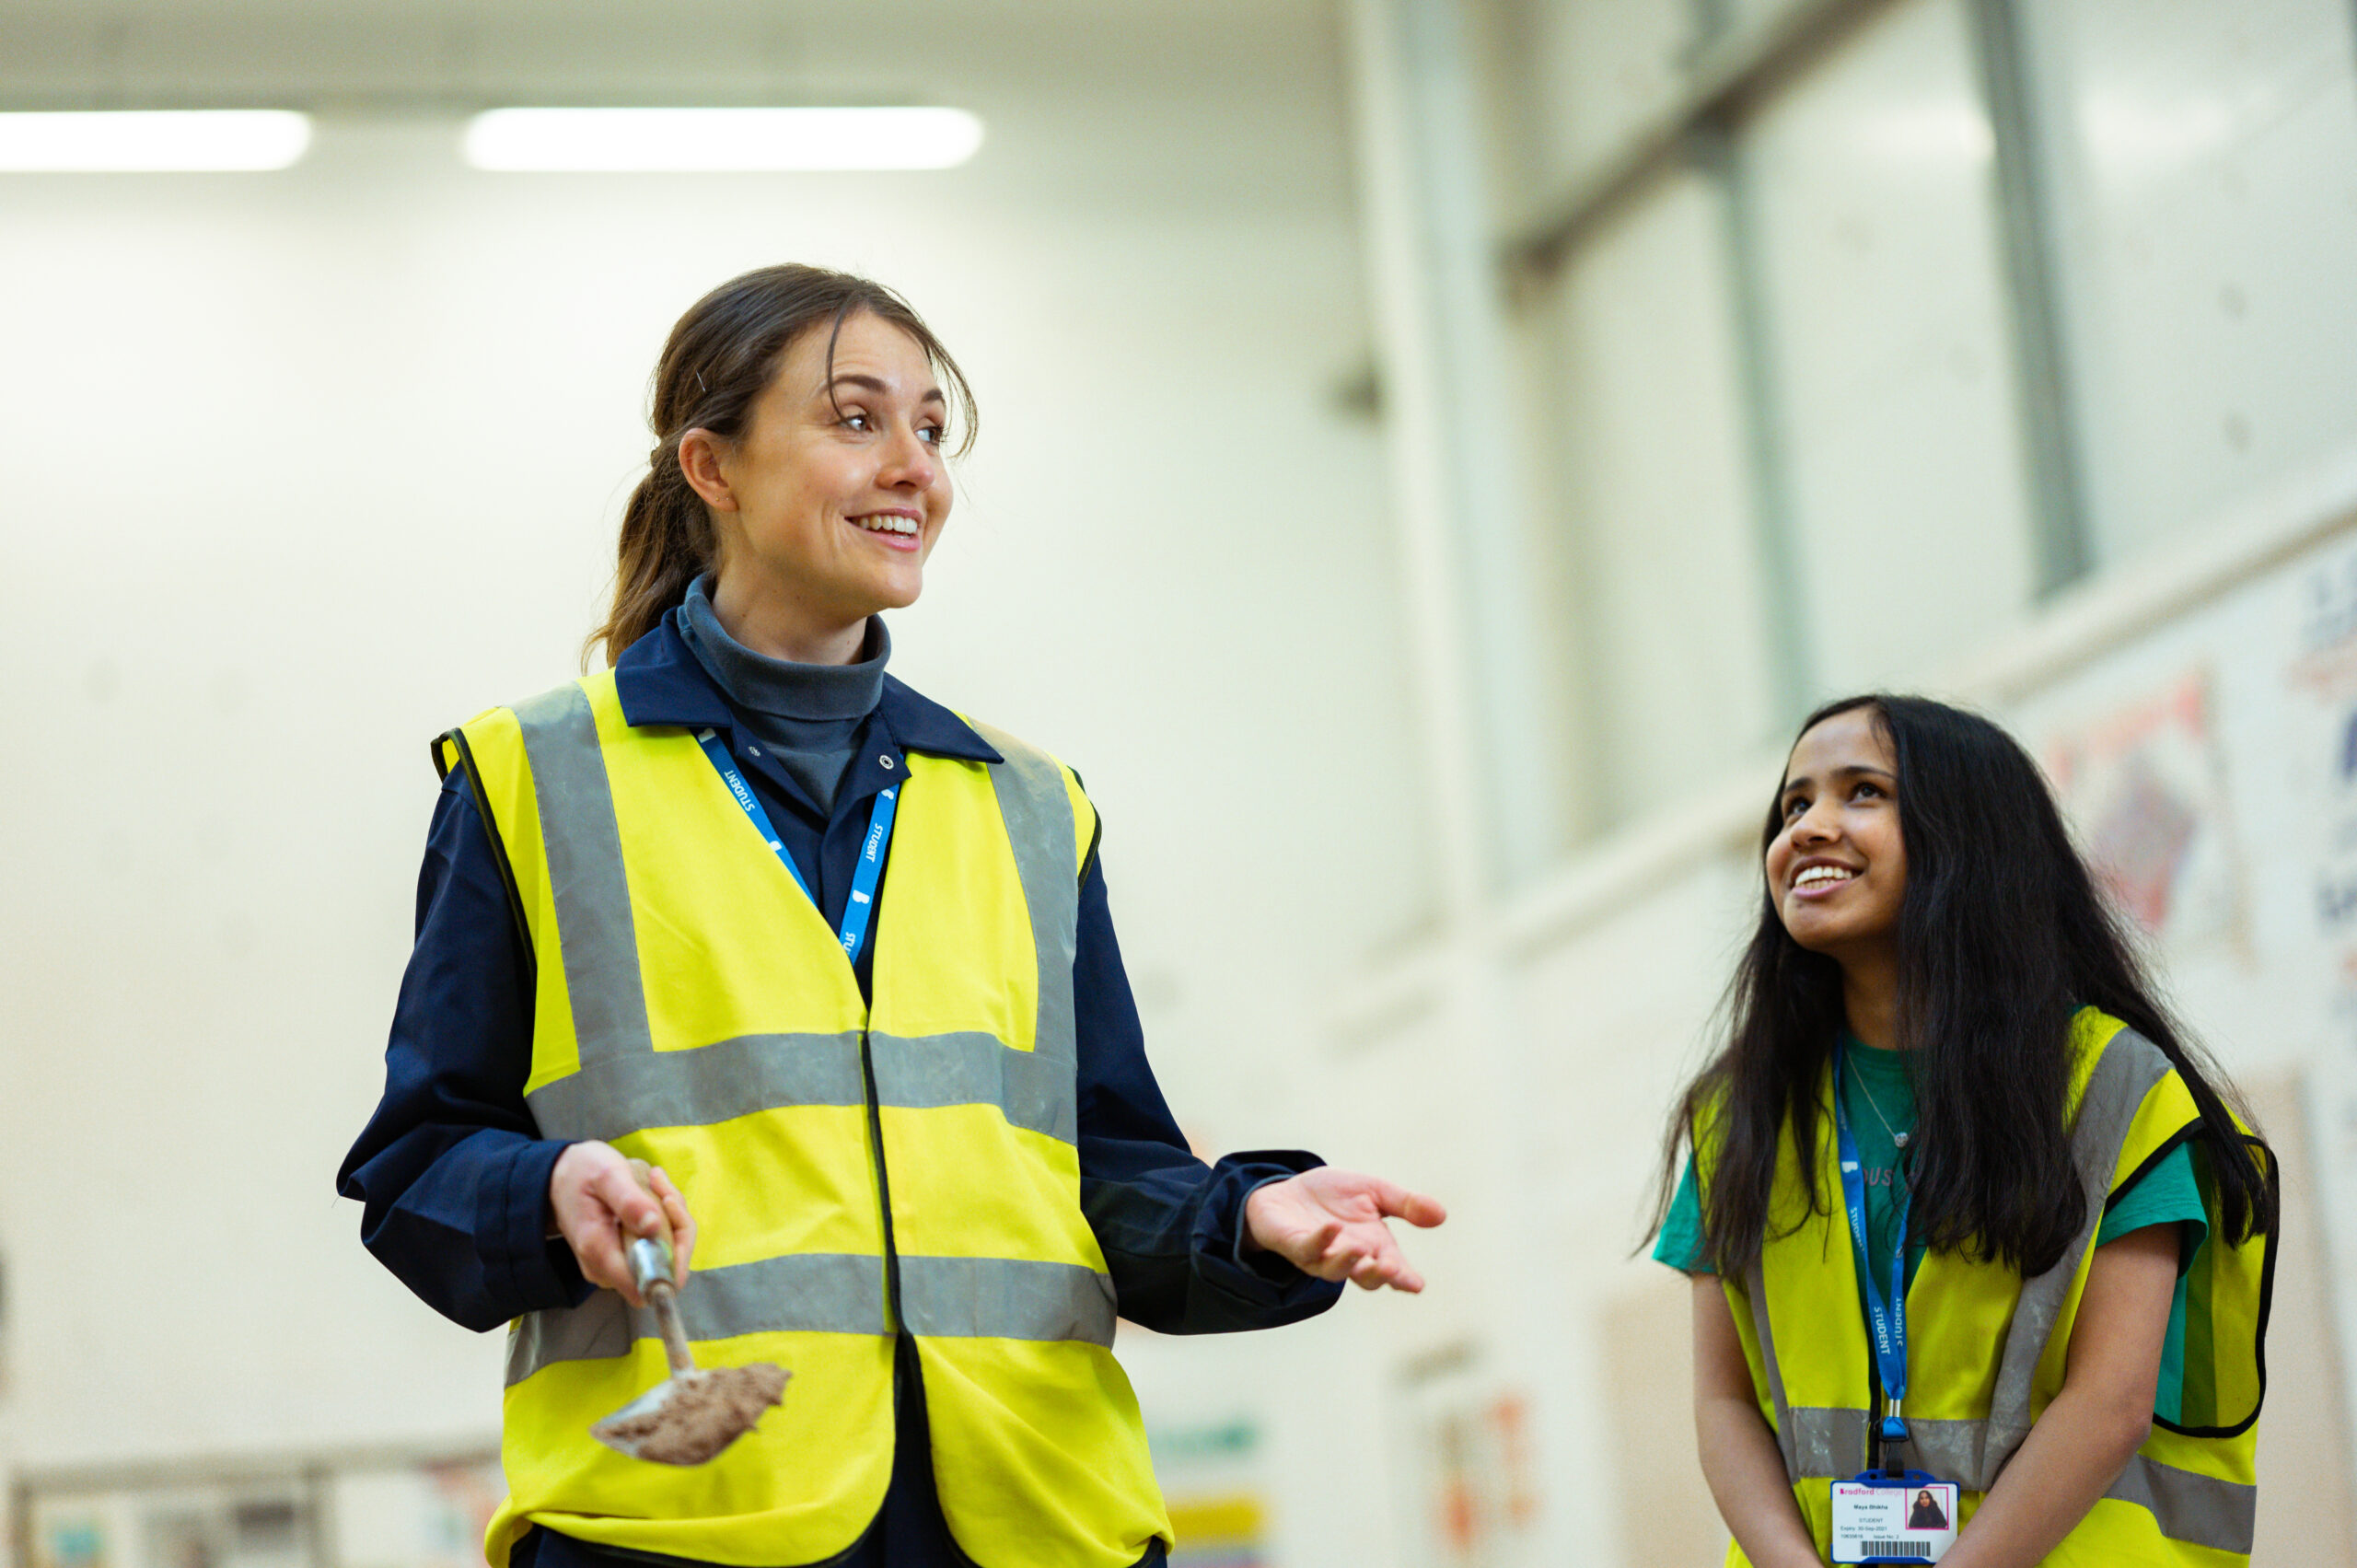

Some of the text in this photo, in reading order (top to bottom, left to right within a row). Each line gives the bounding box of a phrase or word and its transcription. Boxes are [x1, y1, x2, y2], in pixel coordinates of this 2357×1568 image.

[724, 770, 755, 812] STUDENT
[865, 822, 883, 863] STUDENT
[842, 932, 856, 955] STU
[1850, 1207, 1865, 1252] STUDENT
[1874, 1307, 1891, 1355] STUDENT
